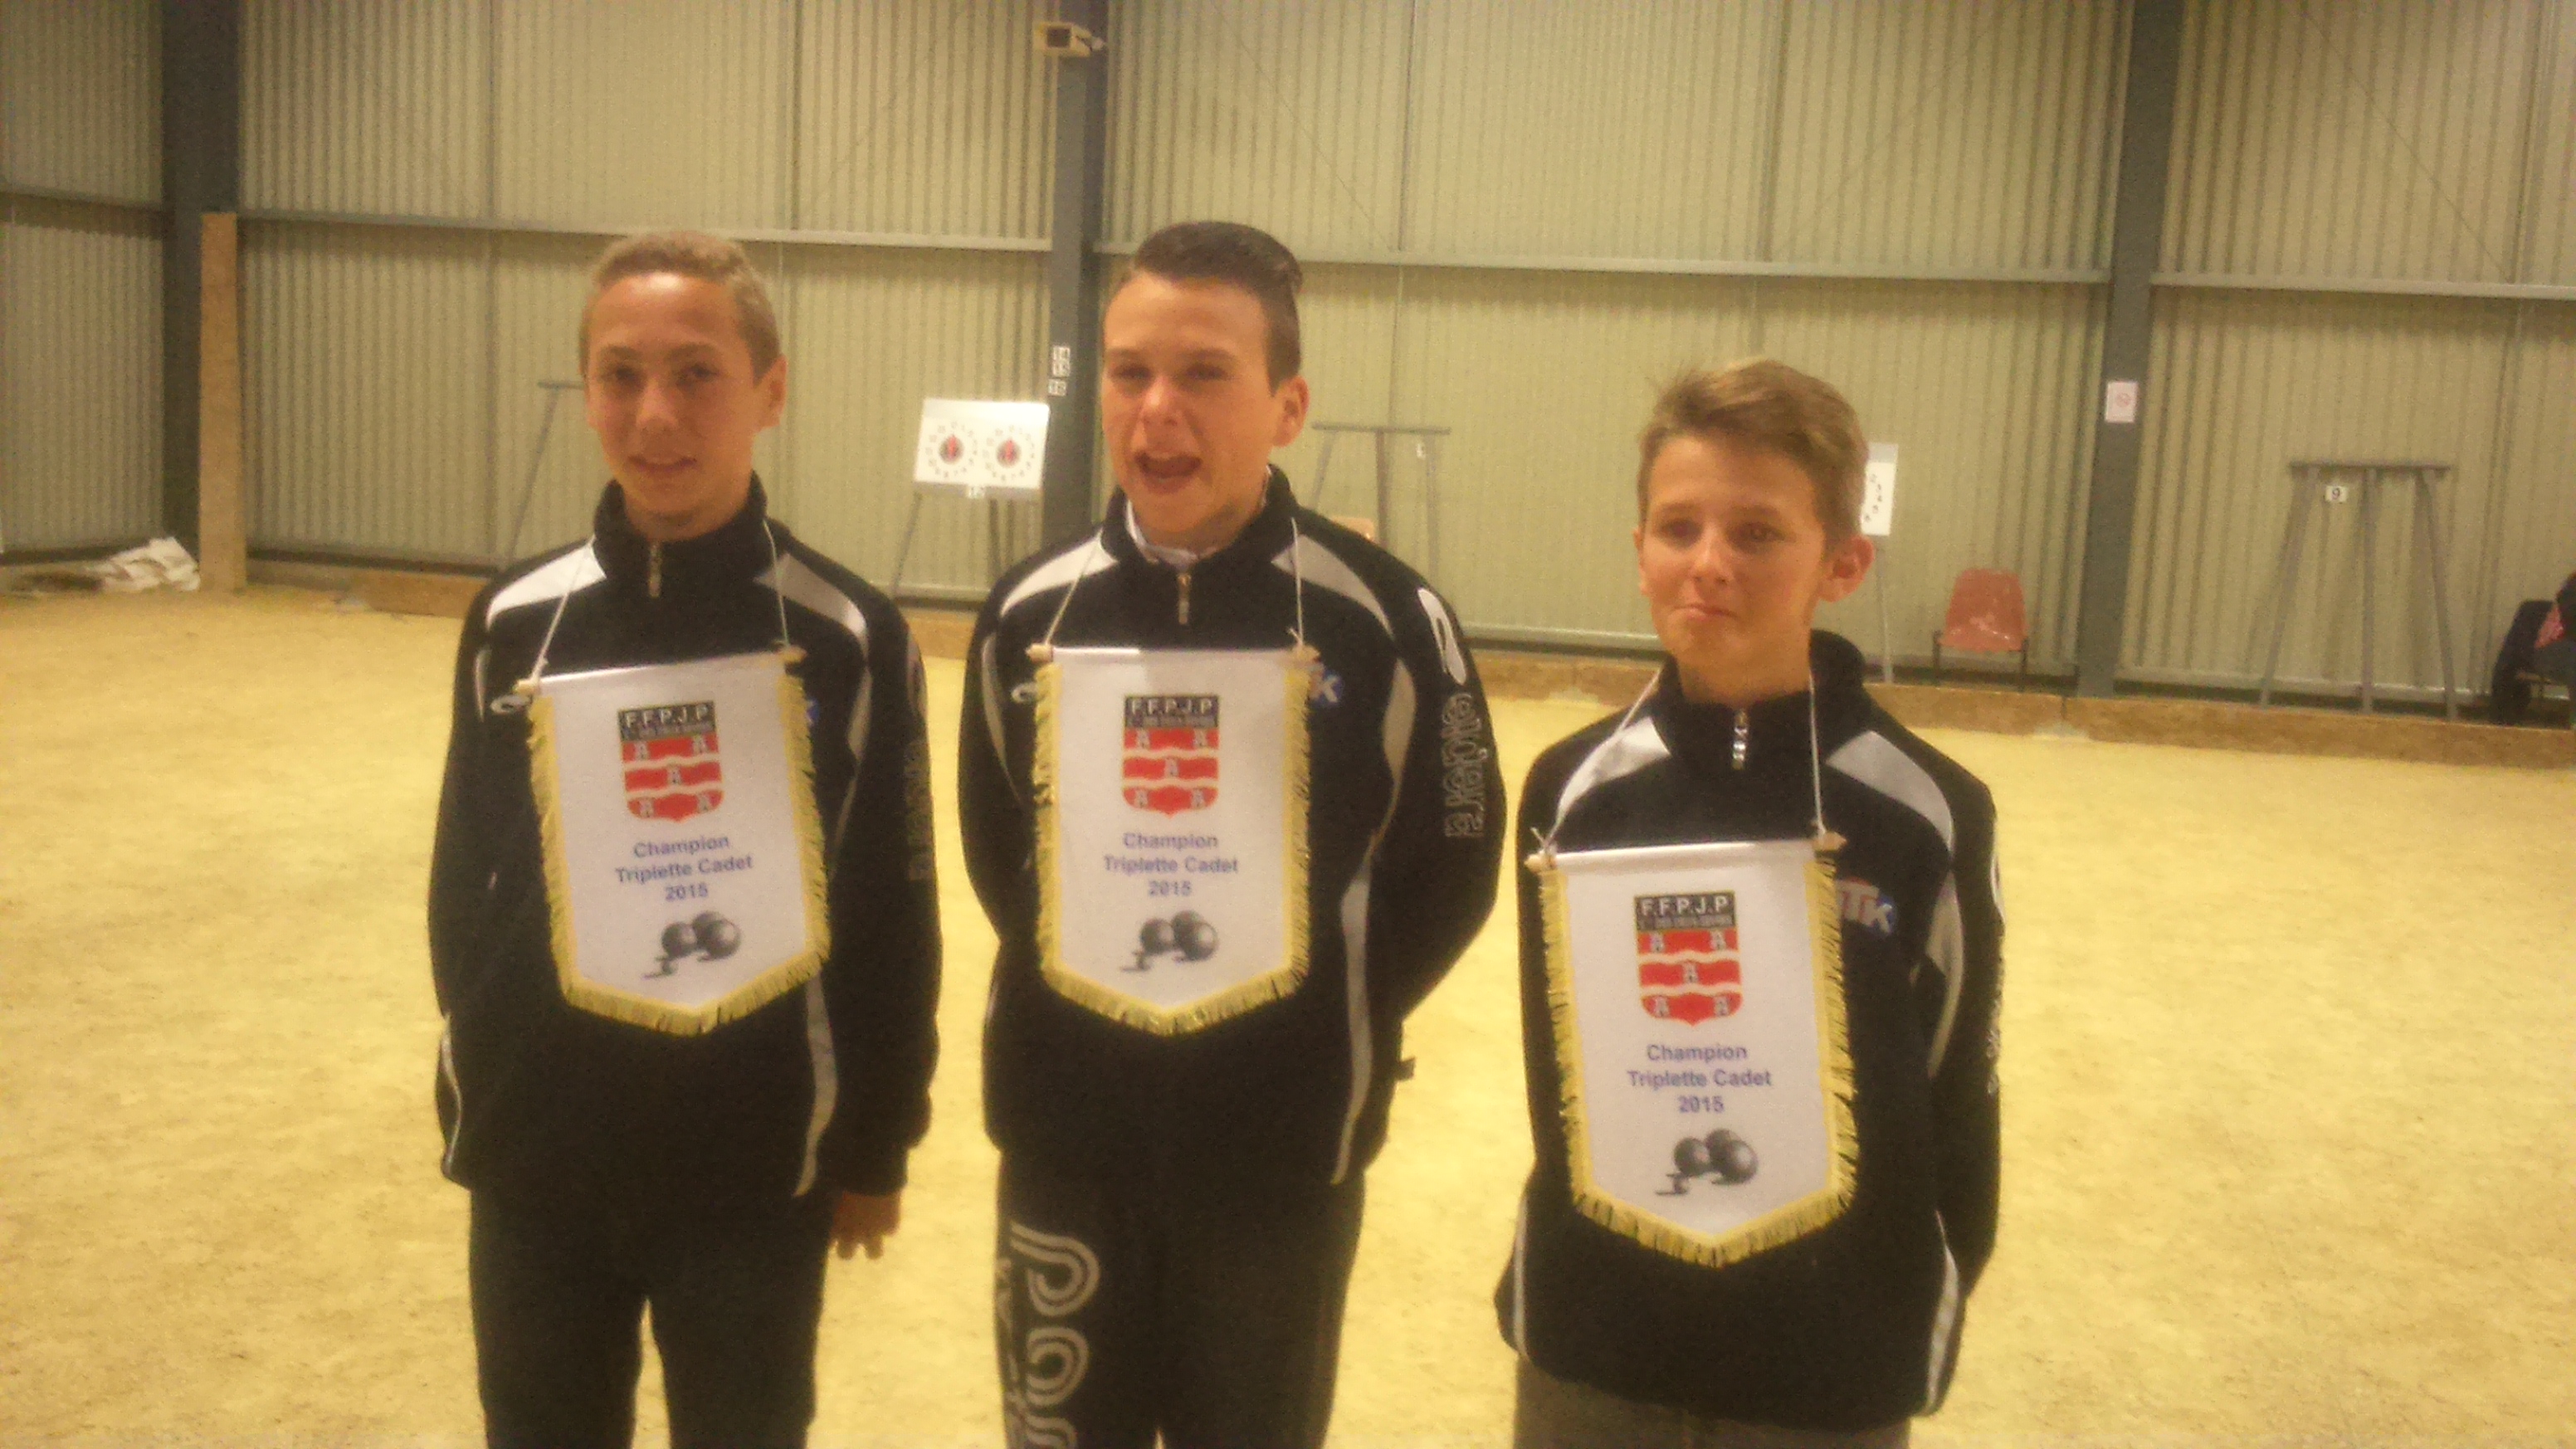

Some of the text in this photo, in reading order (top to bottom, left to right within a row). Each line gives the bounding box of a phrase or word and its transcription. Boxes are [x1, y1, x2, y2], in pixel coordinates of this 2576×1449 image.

[633, 835, 729, 859] Champion
[1122, 832, 1218, 854] Champion
[614, 854, 754, 885] Triplette Cadet
[1104, 855, 1238, 876] Triplette Cadet
[665, 882, 709, 901] 2015
[1148, 880, 1192, 896] 2015
[1646, 1042, 1748, 1065] Champion
[1627, 1067, 1773, 1091] Triplette Cadet
[1678, 1095, 1725, 1114] 2015
